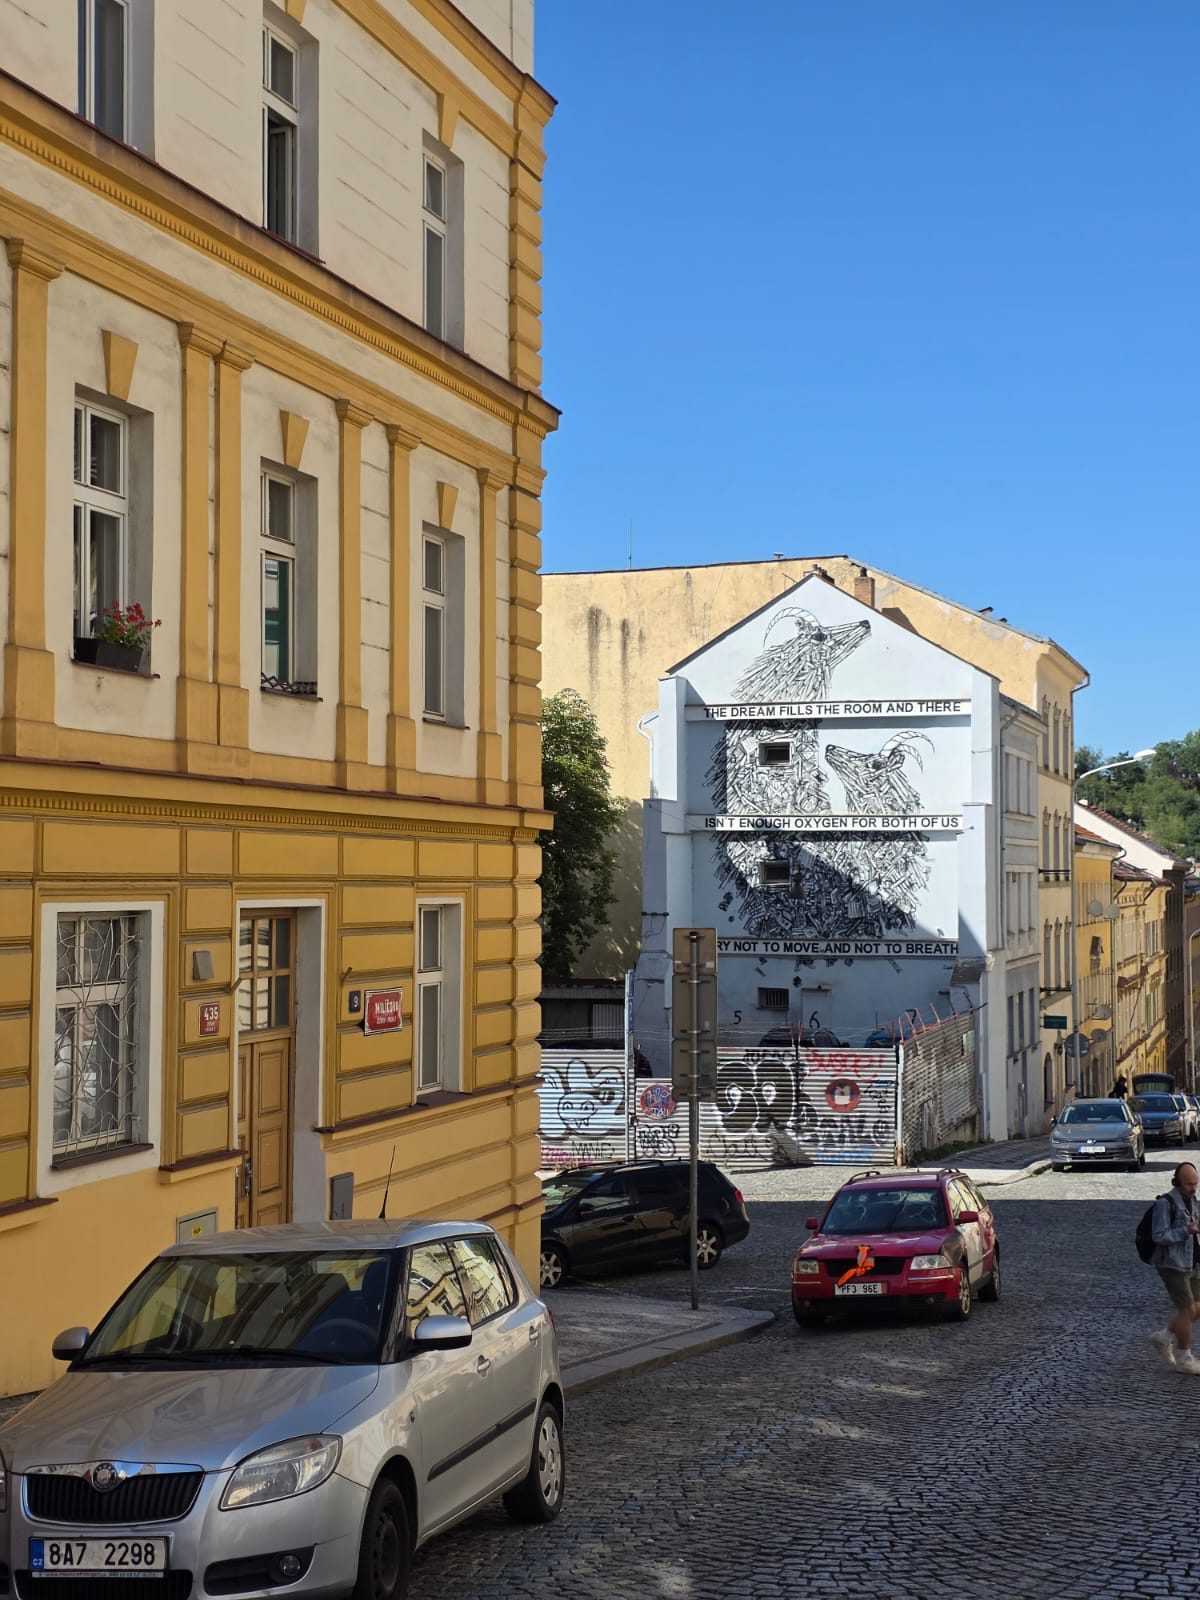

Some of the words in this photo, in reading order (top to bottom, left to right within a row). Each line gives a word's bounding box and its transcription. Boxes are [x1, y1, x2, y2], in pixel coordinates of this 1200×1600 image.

[704, 707, 727, 718] THE
[731, 706, 776, 717] DREAM
[780, 705, 813, 716] FILLS
[816, 704, 840, 715] THE
[844, 703, 882, 714] ROOM
[886, 702, 914, 713] AND
[918, 701, 961, 712] THERE
[740, 818, 791, 829] ENOUGH
[794, 817, 848, 829] OXYGEN
[852, 817, 877, 828] FOR
[881, 817, 917, 828] BOTH
[921, 817, 939, 828] OF
[941, 817, 959, 828] US
[717, 941, 731, 952] RY
[733, 941, 758, 952] NOT
[763, 941, 780, 952] TO
[824, 943, 851, 954] AND
[854, 943, 880, 954] NOT
[884, 943, 902, 954] TO
[353, 995, 359, 1008] 9
[203, 1006, 219, 1020] 435
[733, 1010, 742, 1025] 5
[809, 1010, 820, 1029] 6
[33, 1558, 43, 1566] CZ
[50, 1543, 87, 1566] 8A7
[104, 1543, 155, 1566] 2298
